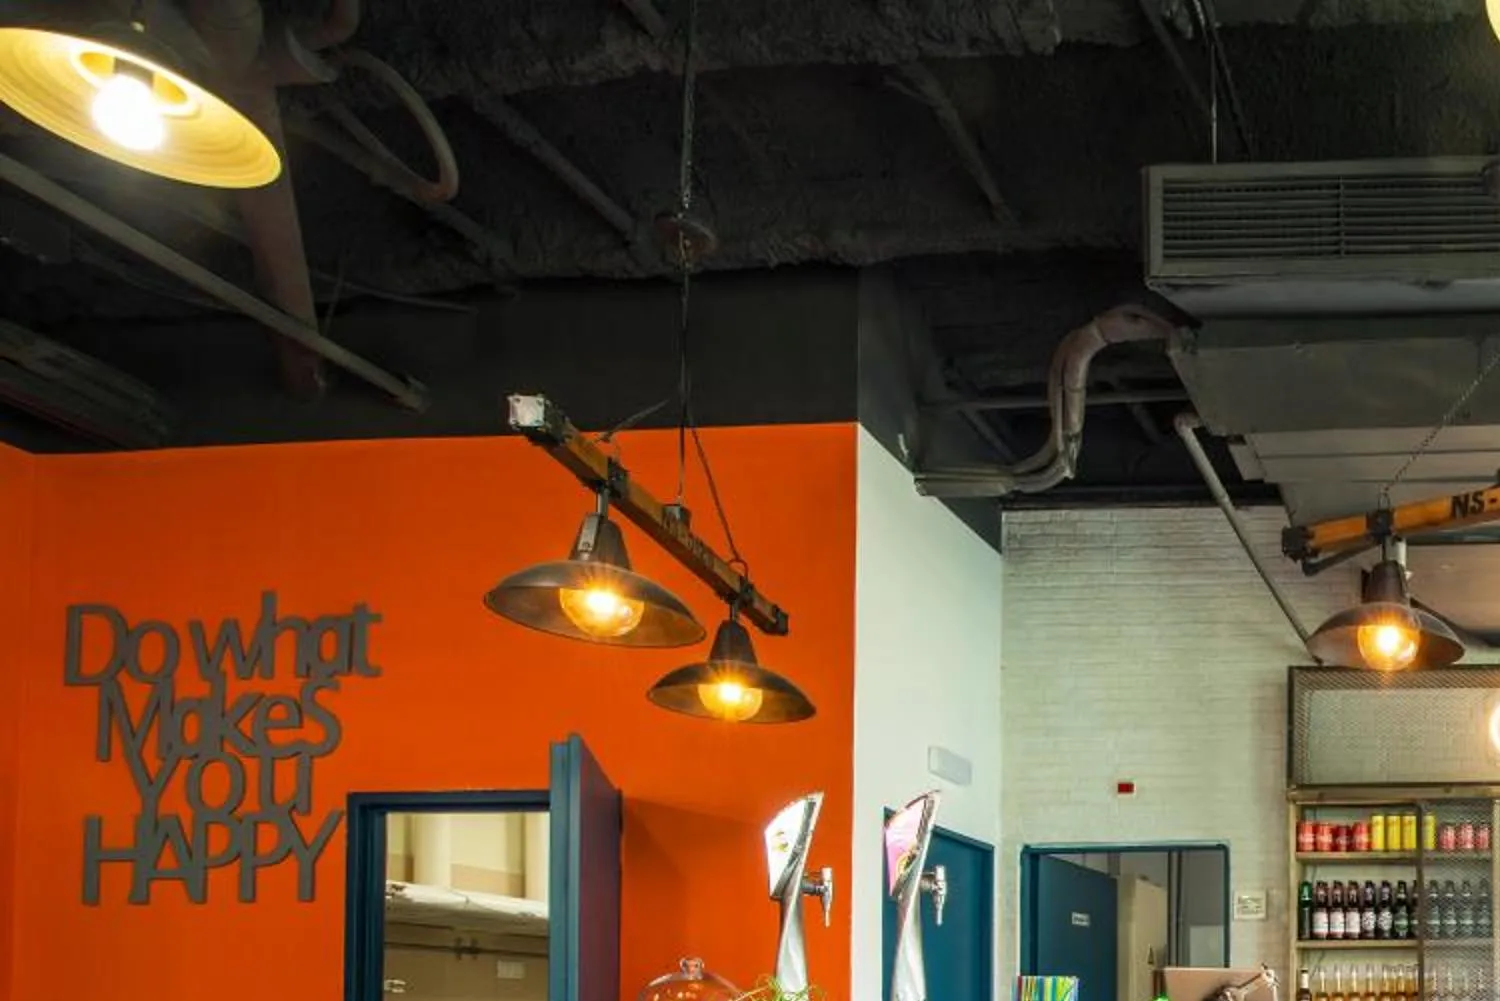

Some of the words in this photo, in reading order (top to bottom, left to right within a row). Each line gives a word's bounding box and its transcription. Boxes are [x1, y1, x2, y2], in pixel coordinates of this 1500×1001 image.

[64, 603, 181, 686] Do
[188, 590, 383, 680] what
[82, 809, 346, 906] HAPPY
